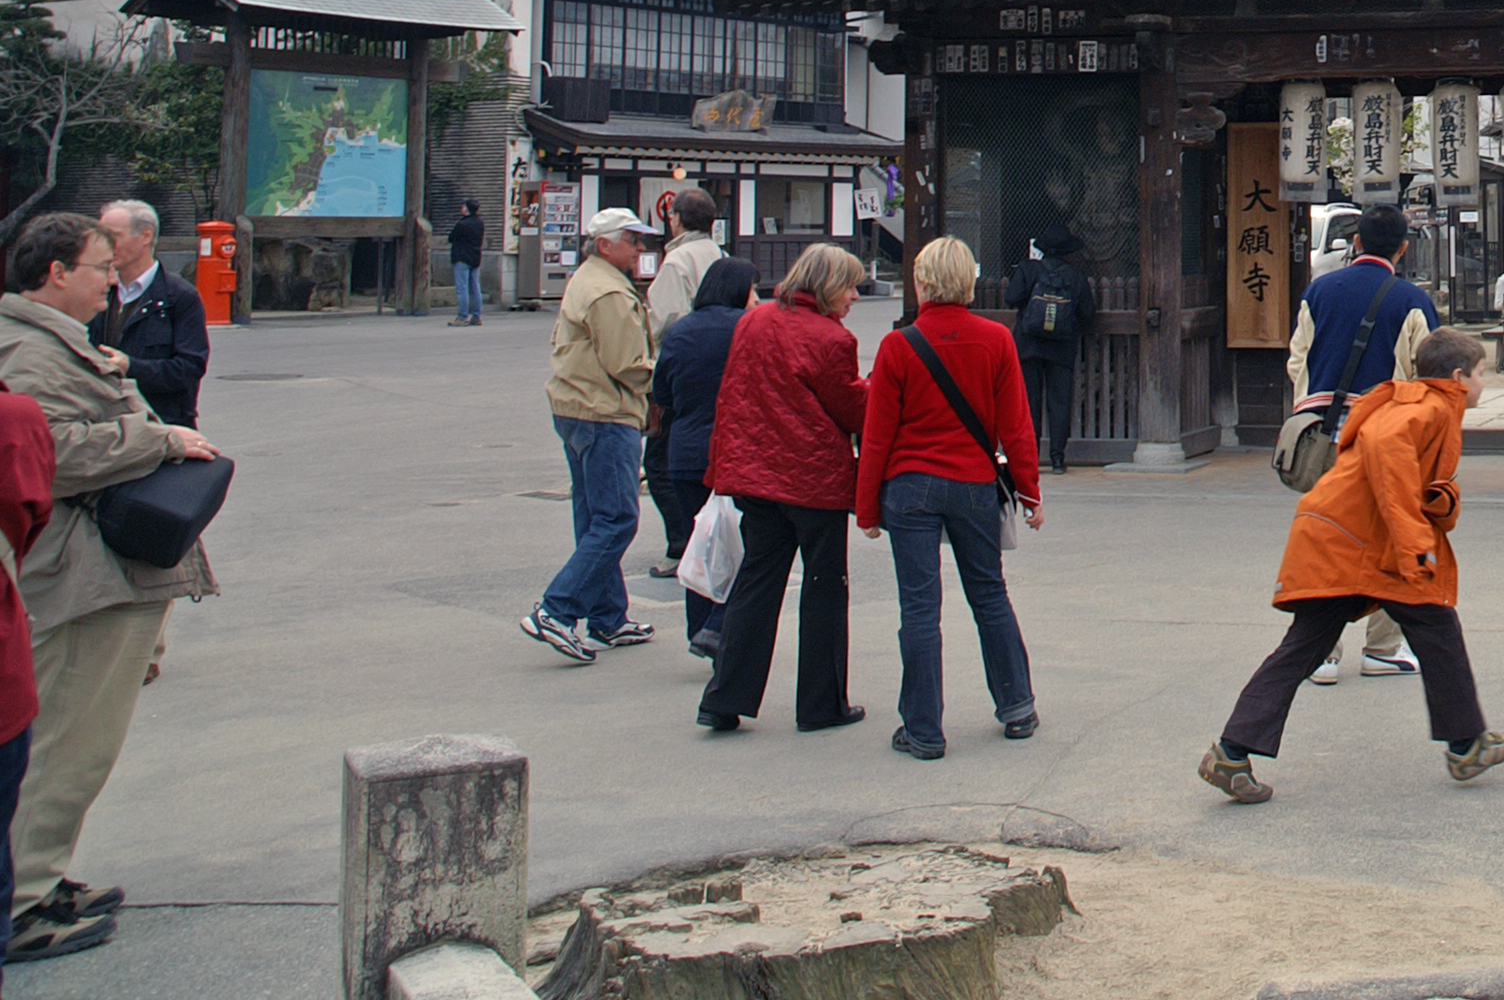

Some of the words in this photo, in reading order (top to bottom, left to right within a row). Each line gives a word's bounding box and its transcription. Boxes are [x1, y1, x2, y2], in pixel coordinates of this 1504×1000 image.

[1281, 107, 1294, 161] 大願寺
[1361, 94, 1385, 175] 厳島弁財天
[1437, 96, 1459, 179] 厳島弁財天
[1238, 179, 1277, 303] 大願寺
